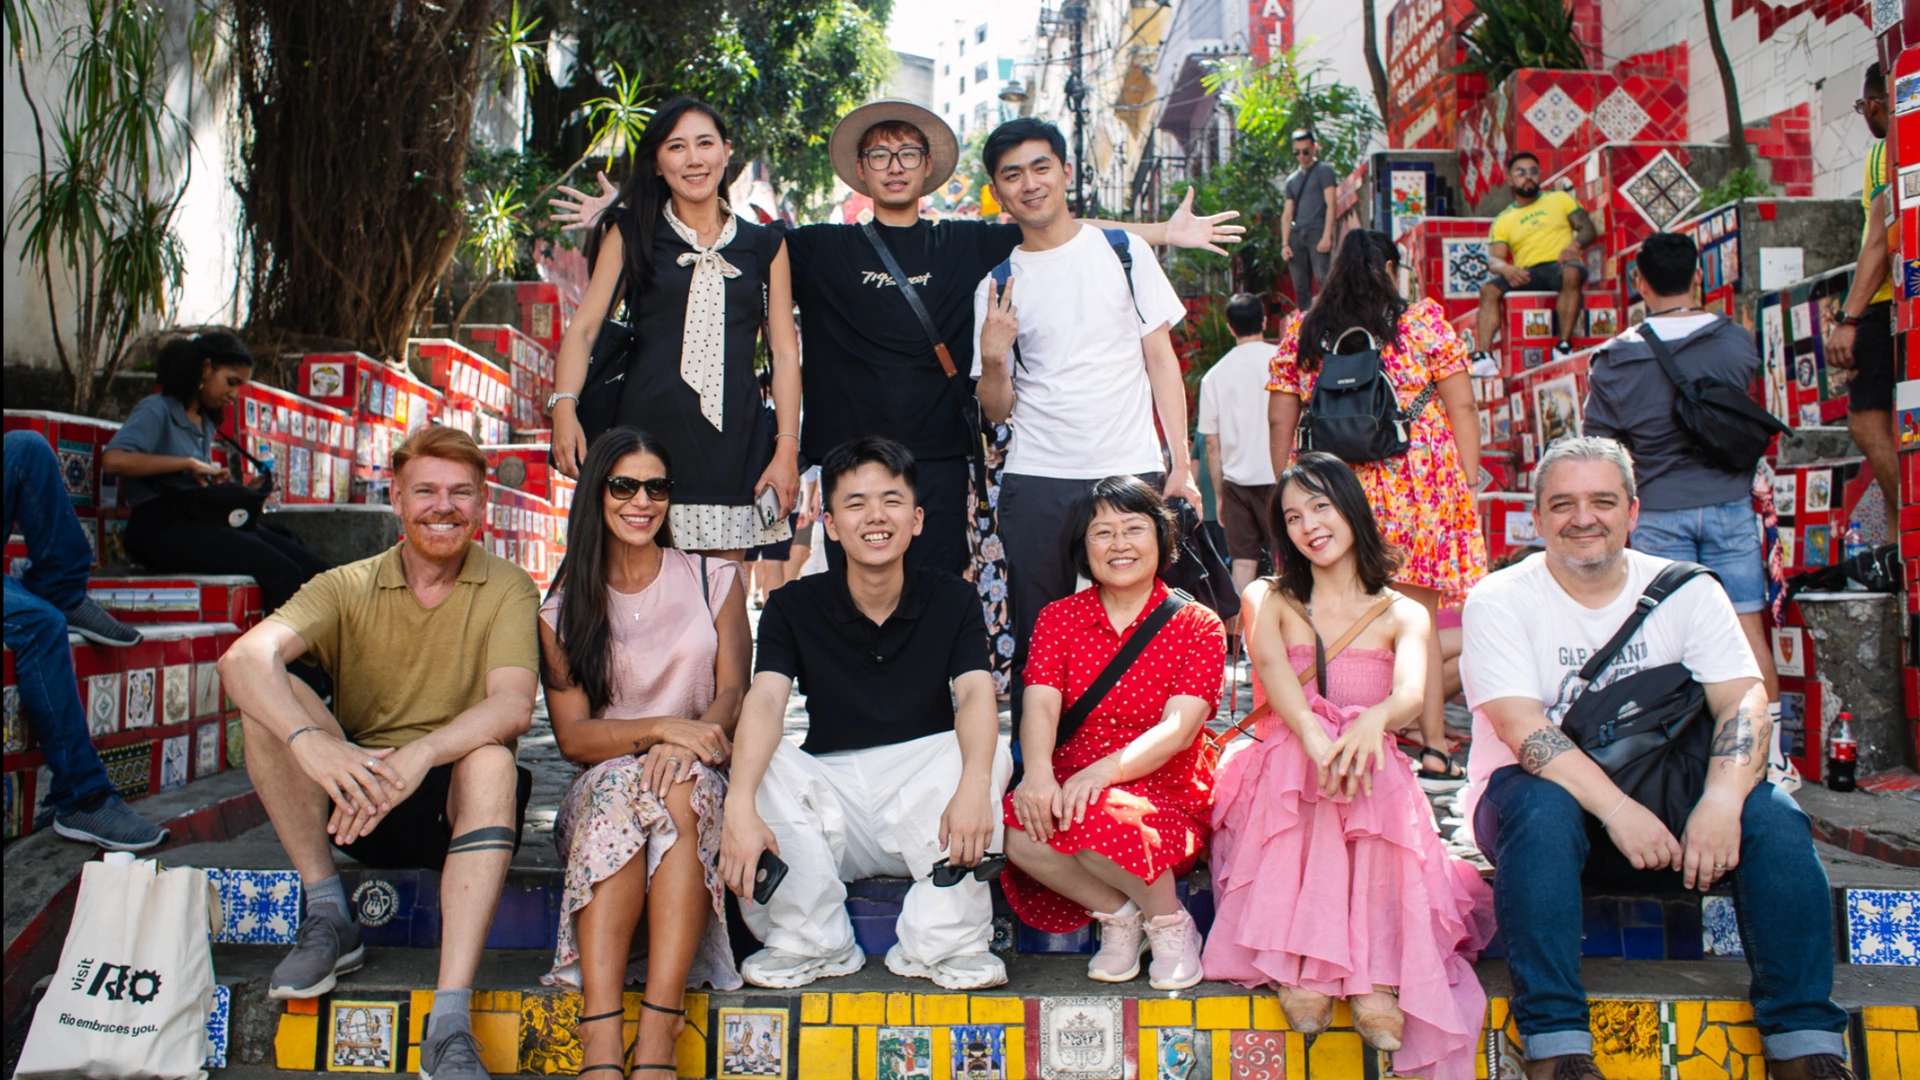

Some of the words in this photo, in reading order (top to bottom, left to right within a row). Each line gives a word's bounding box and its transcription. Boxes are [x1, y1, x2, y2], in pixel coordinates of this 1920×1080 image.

[1558, 646, 1588, 666] GAP
[71, 957, 95, 991] visit
[58, 1012, 76, 1026] Rio
[76, 1018, 131, 1035] embraces
[131, 1024, 159, 1038] you.
